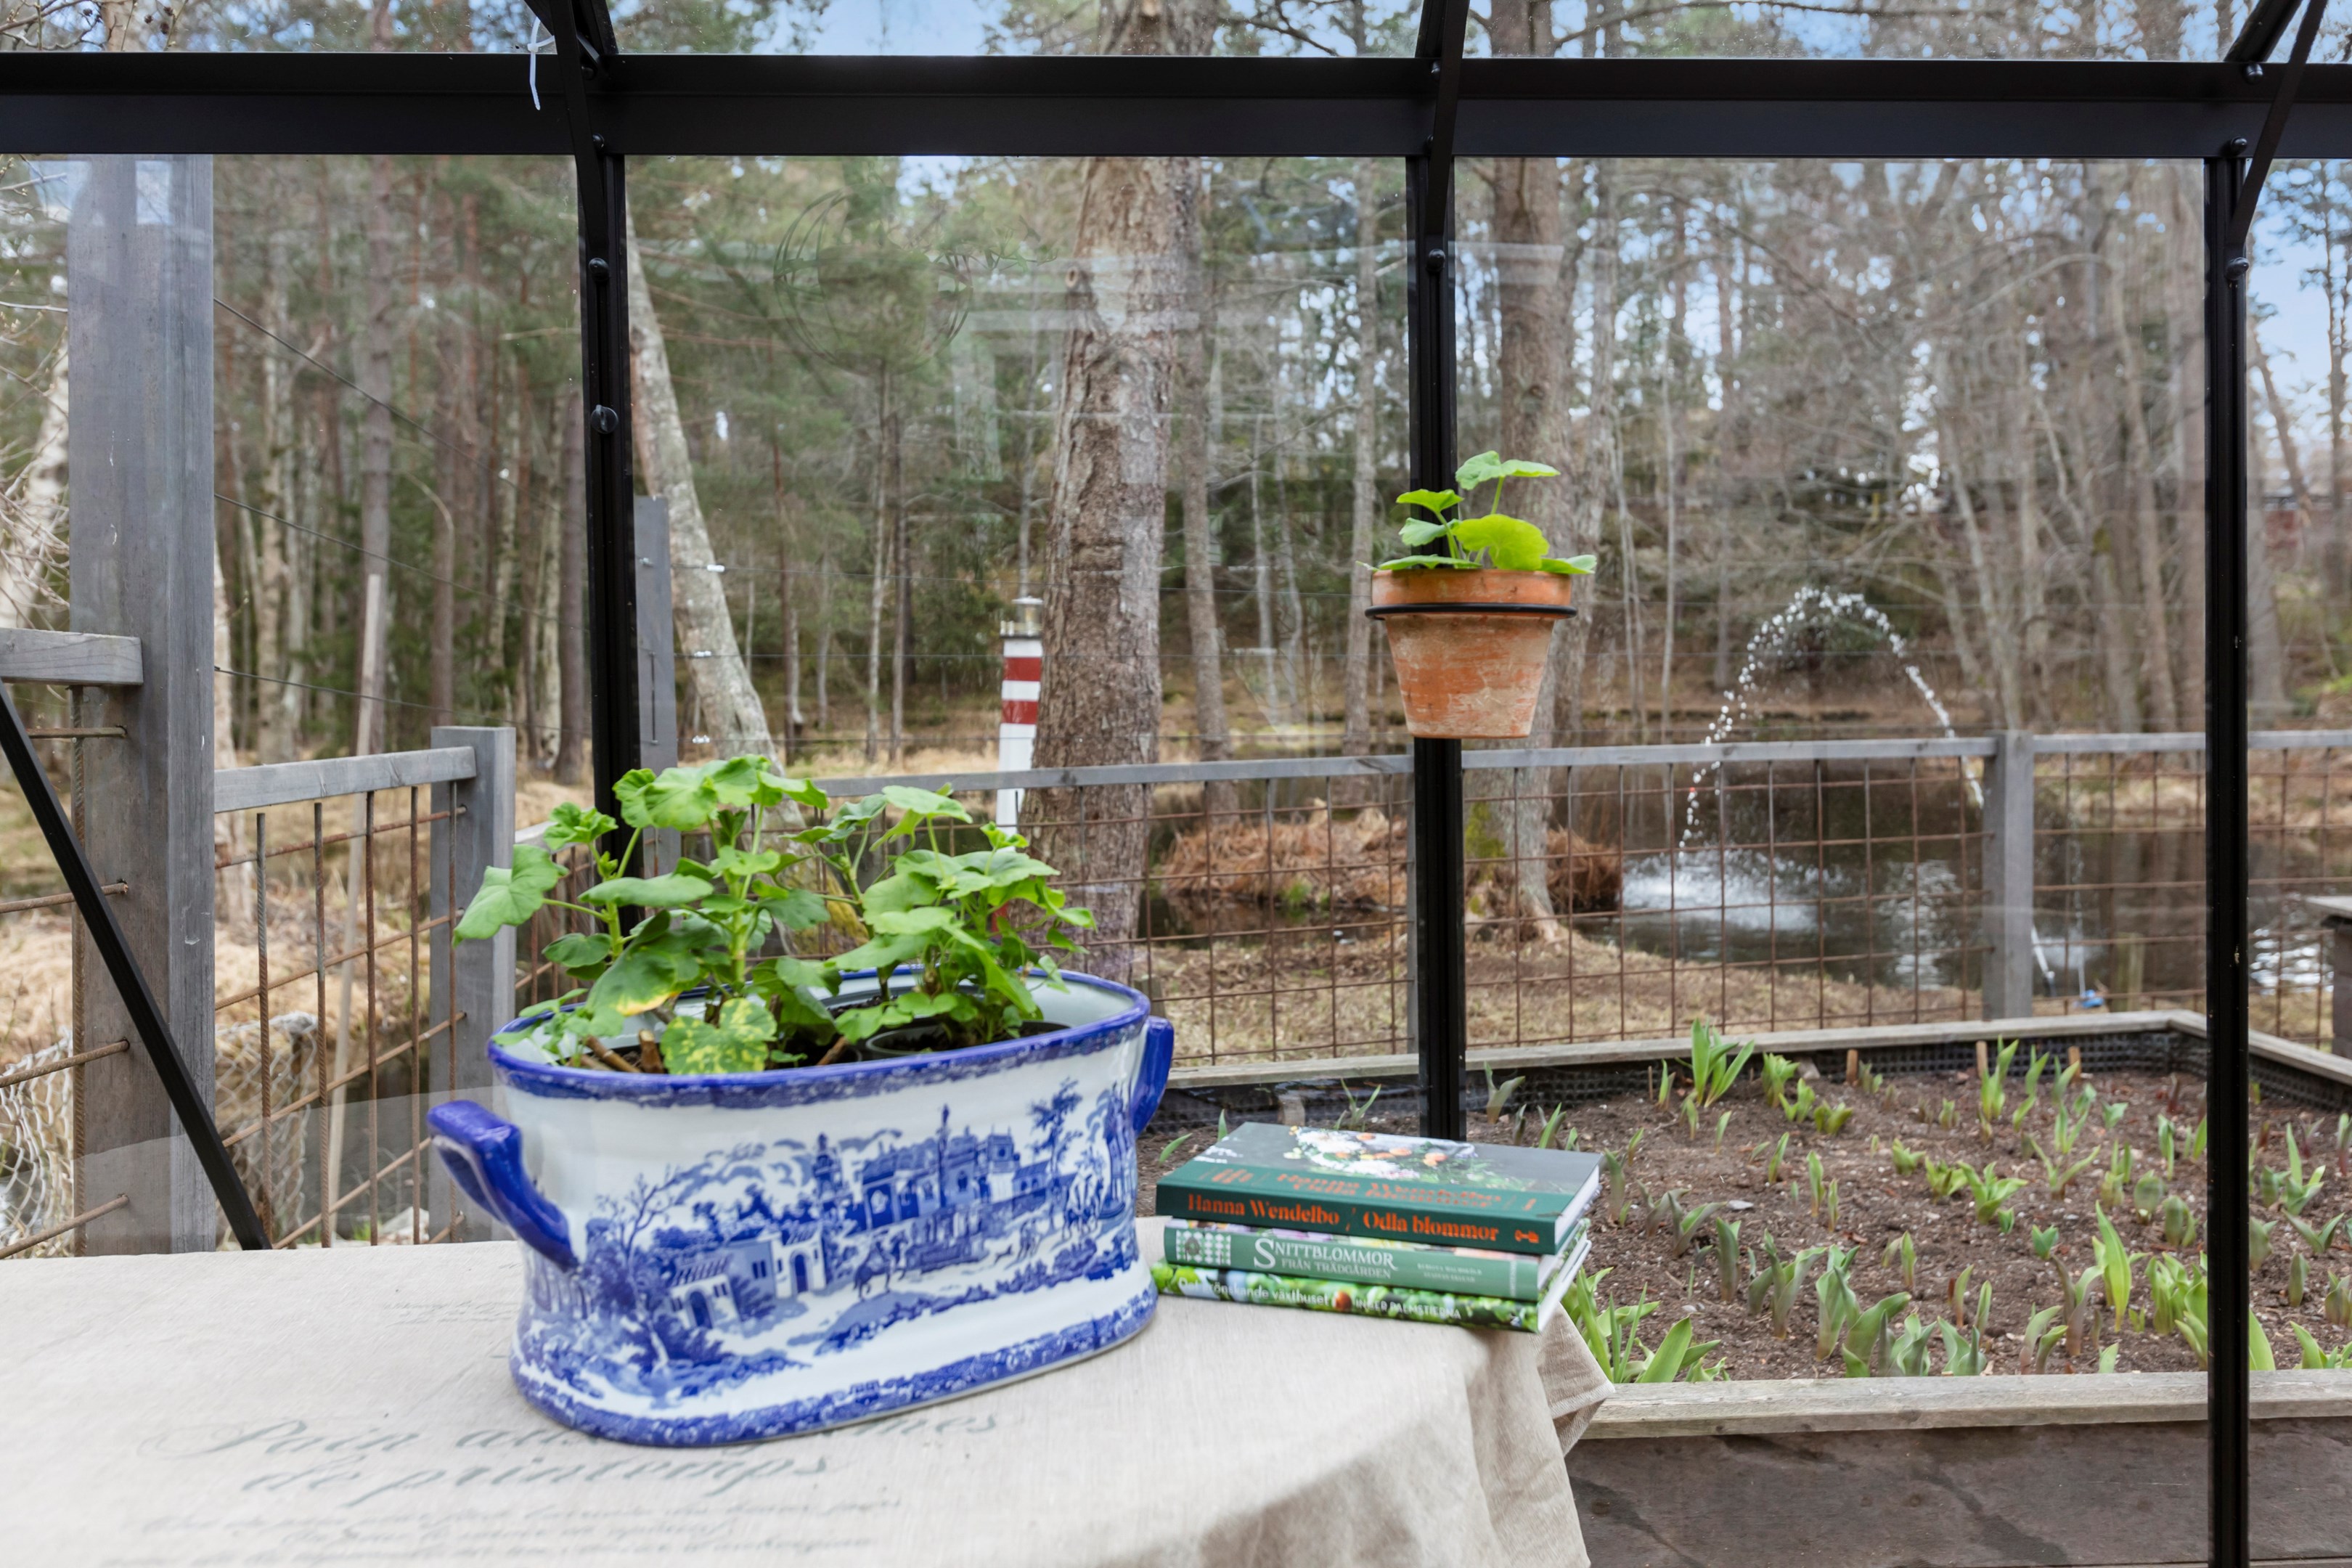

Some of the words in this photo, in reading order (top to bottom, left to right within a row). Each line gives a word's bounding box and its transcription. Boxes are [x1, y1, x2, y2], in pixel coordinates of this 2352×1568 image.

[1188, 1193, 1245, 1216] Hanna
[1249, 1199, 1339, 1225] Wendelbo
[1363, 1211, 1408, 1233] Odla
[1413, 1215, 1499, 1241] blommor
[1254, 1238, 1398, 1270] SNITTBLOMMOR
[1281, 1257, 1311, 1270] FRÅN
[1314, 1260, 1391, 1279] TRÄDGÅRDEN
[1272, 1288, 1330, 1306] växthuset
